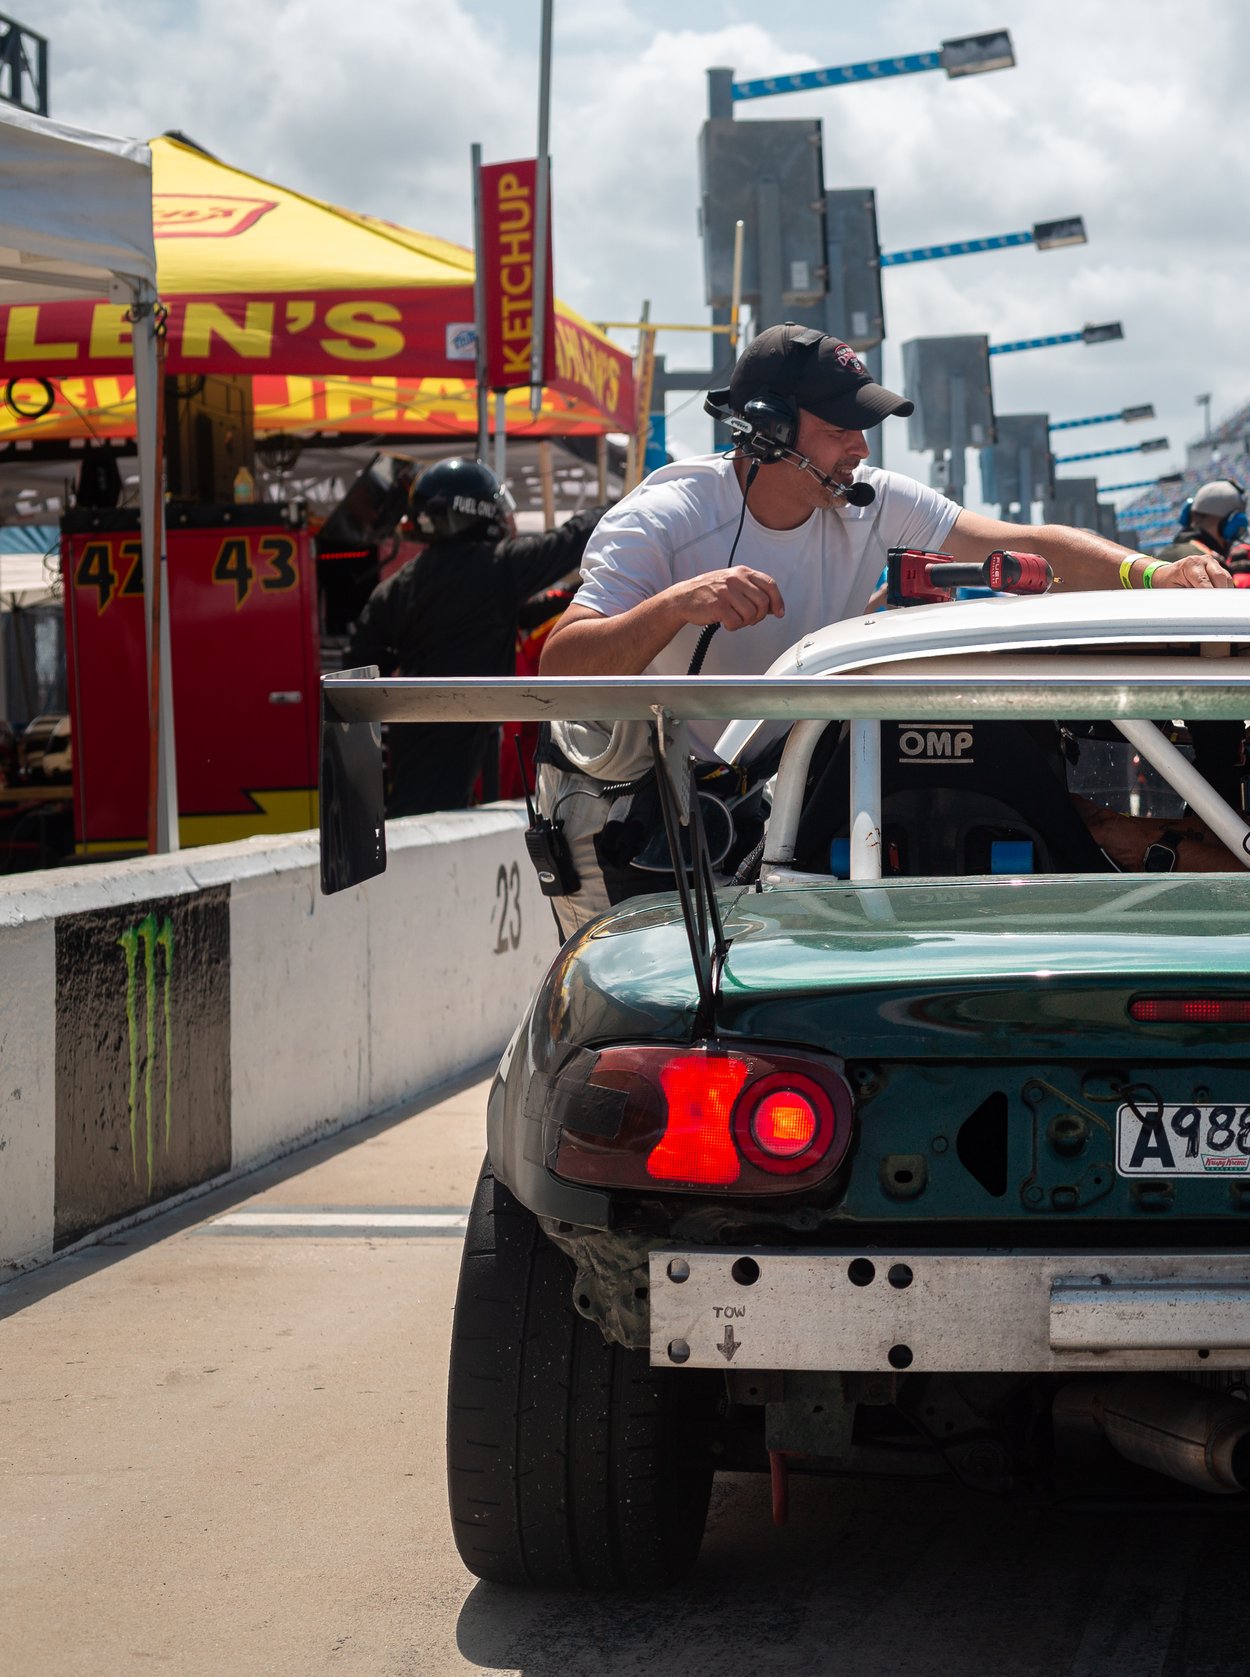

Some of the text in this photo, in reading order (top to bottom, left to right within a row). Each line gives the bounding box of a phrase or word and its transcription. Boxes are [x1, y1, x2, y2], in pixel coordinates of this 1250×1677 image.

[498, 172, 532, 375] KETCHUP
[212, 535, 303, 612] 43
[899, 730, 974, 757] OMP
[493, 860, 522, 955] 23
[1205, 1157, 1248, 1168] Krispy Kreme
[712, 1305, 746, 1319] TOW
